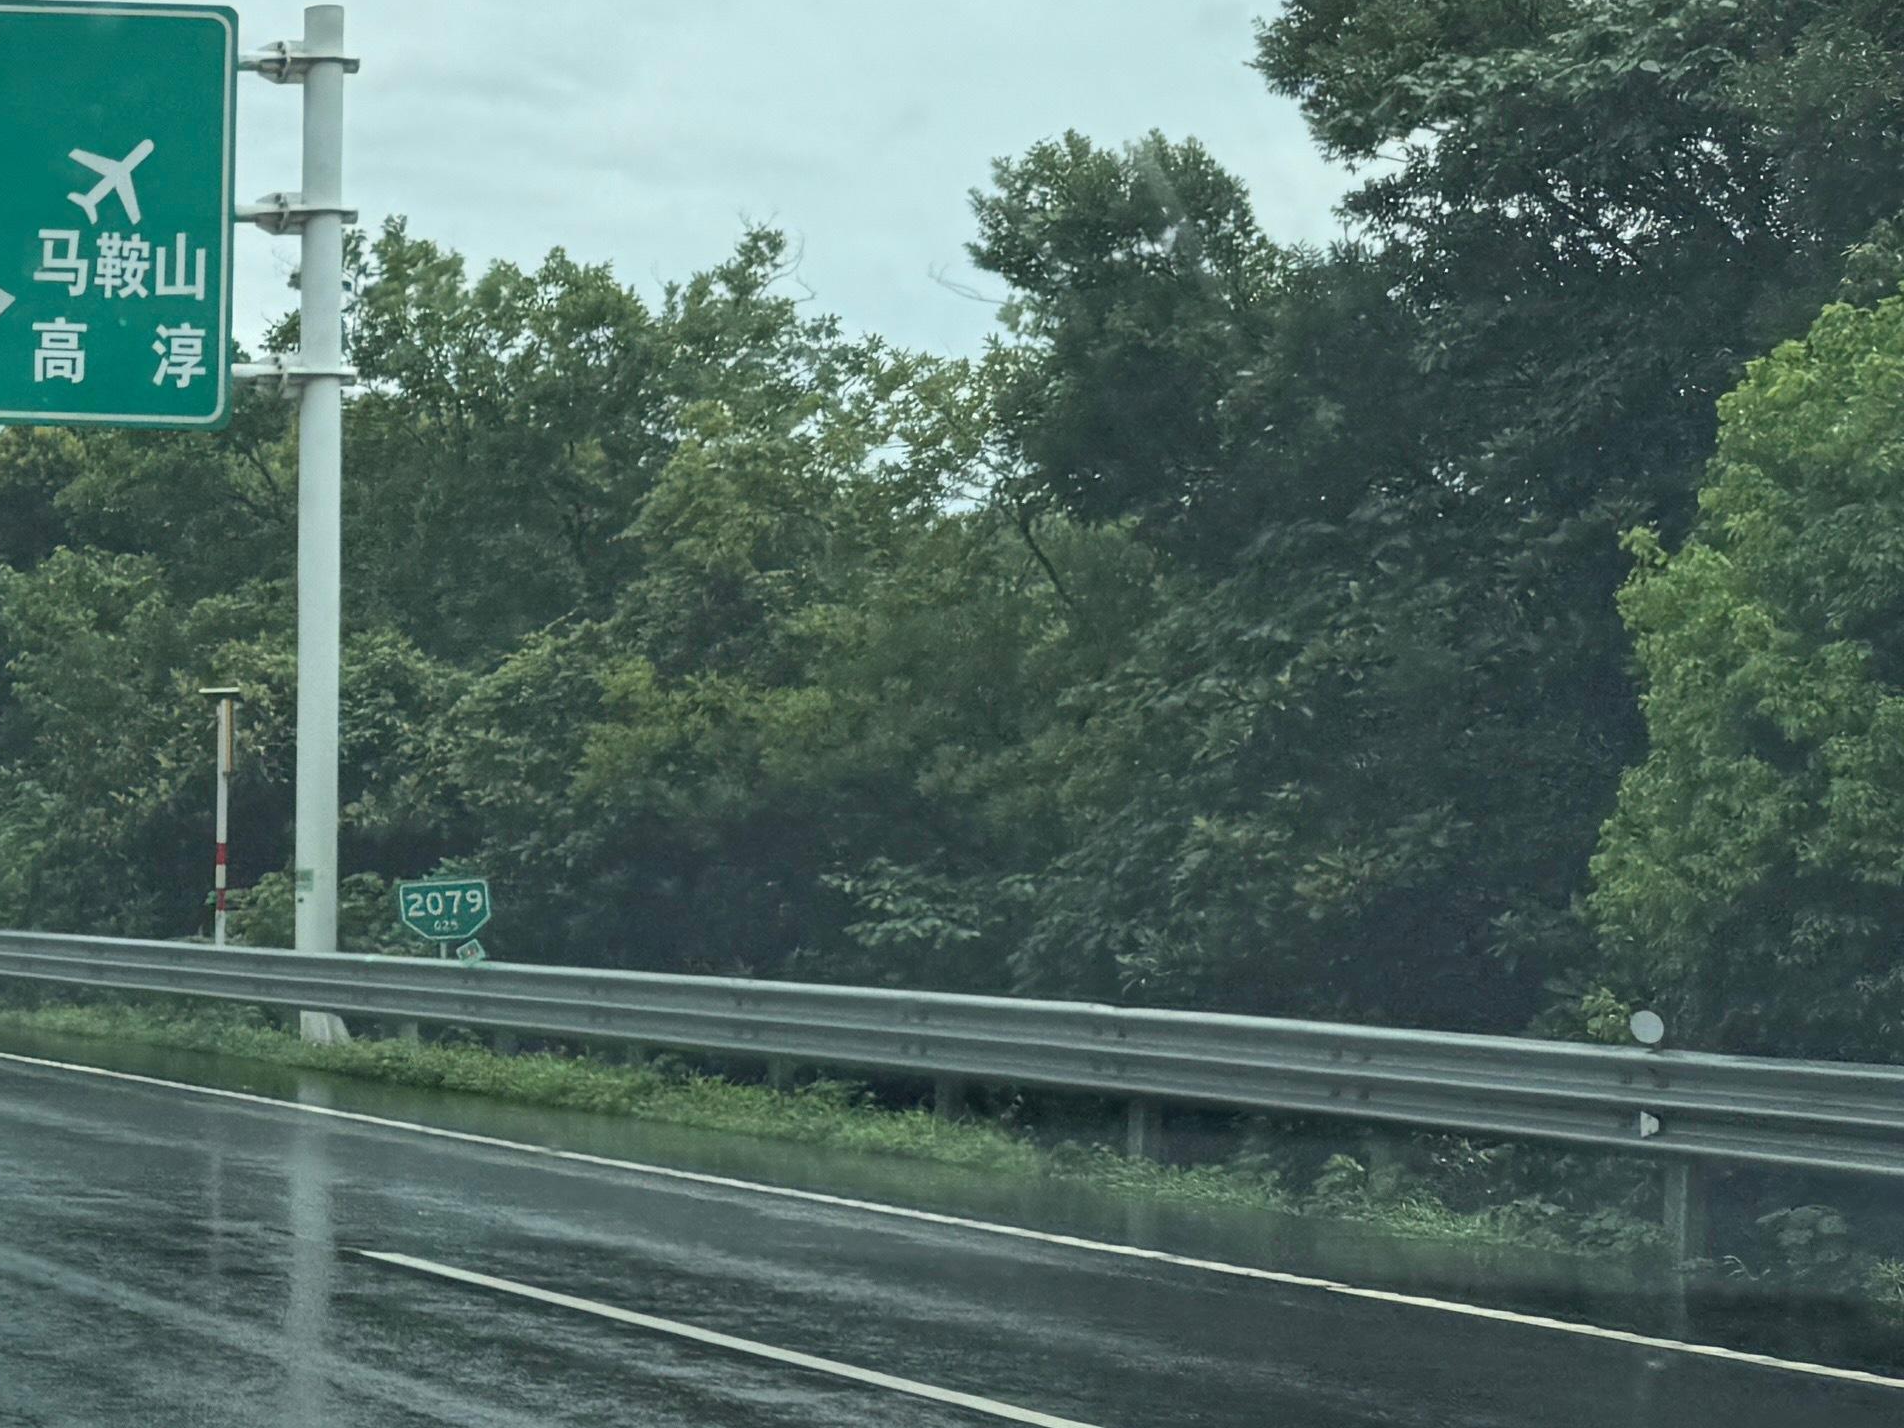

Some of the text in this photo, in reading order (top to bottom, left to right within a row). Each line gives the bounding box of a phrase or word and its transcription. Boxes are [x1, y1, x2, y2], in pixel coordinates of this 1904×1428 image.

[33, 229, 206, 300] 马鞍山
[32, 317, 206, 388] 高淳
[407, 890, 483, 917] 2079
